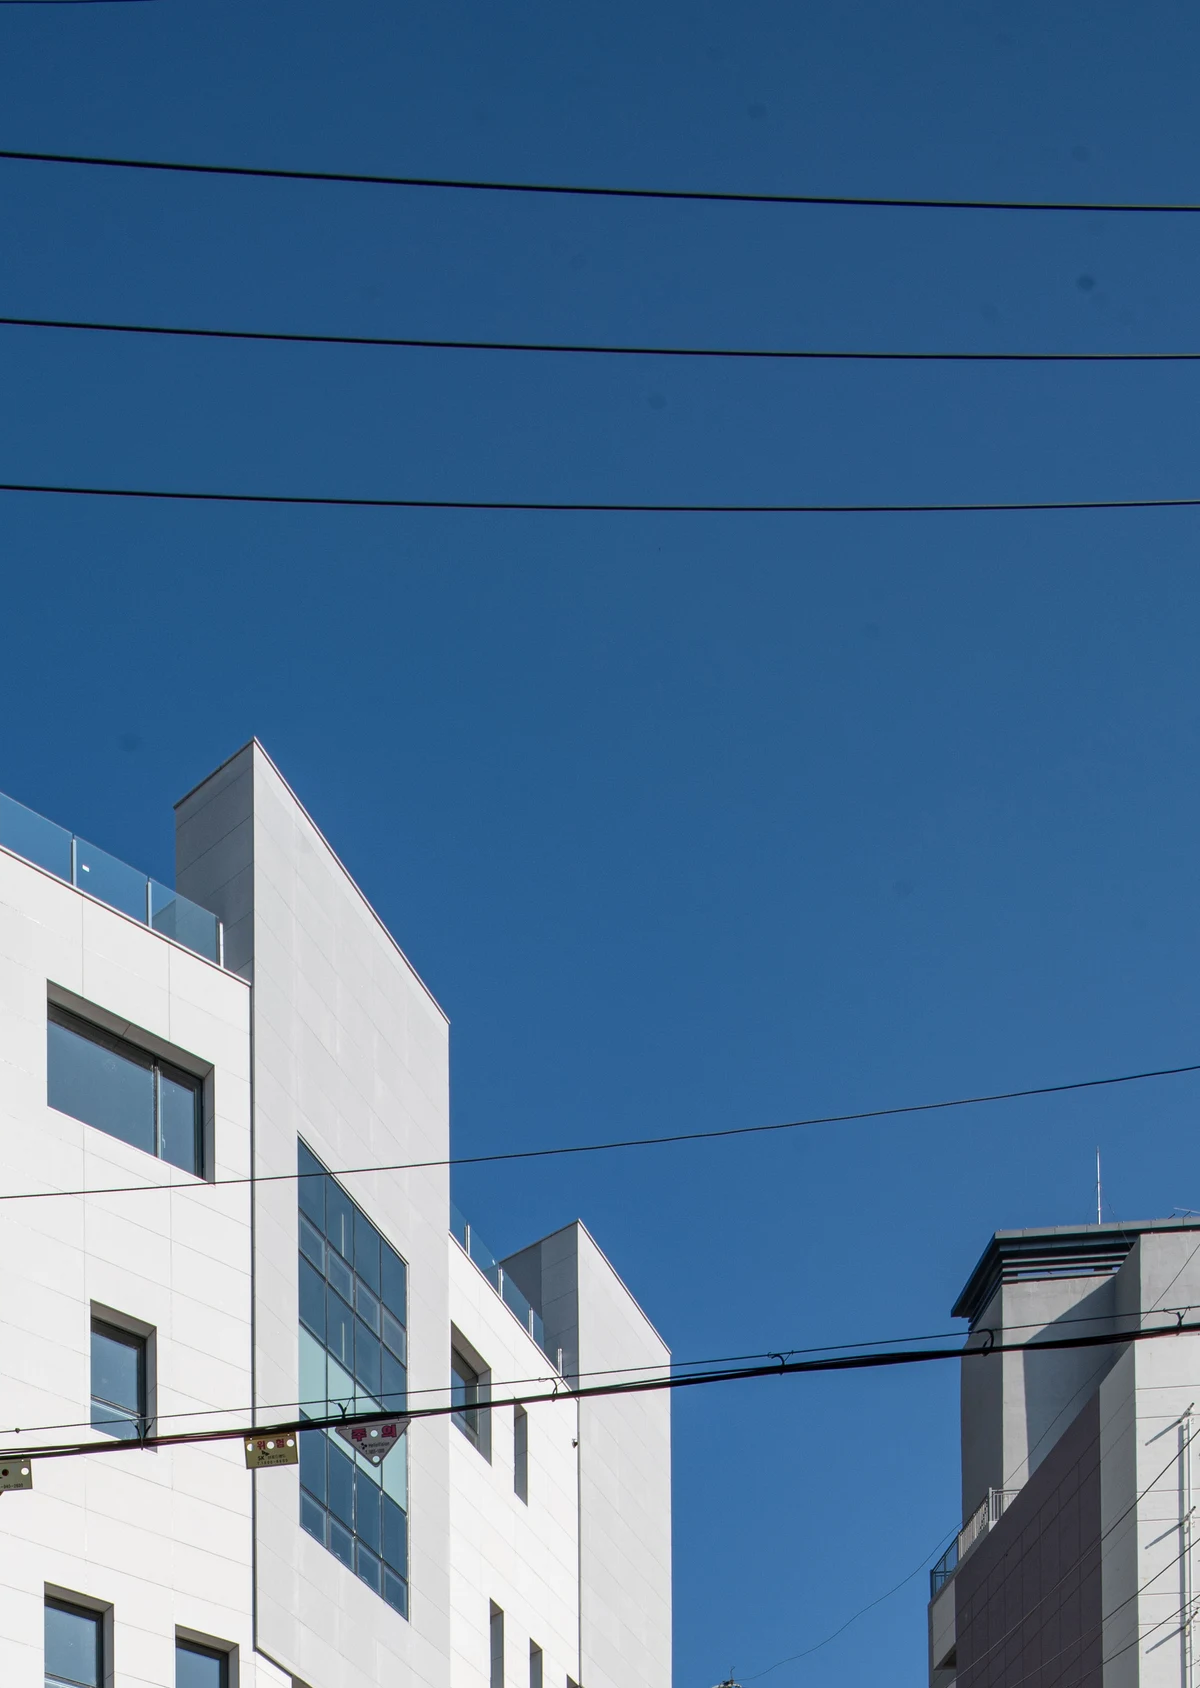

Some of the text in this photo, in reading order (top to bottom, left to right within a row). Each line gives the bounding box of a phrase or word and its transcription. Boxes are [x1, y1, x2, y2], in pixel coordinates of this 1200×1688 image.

[351, 1424, 397, 1442] 주 의
[257, 1439, 285, 1450] 위 험
